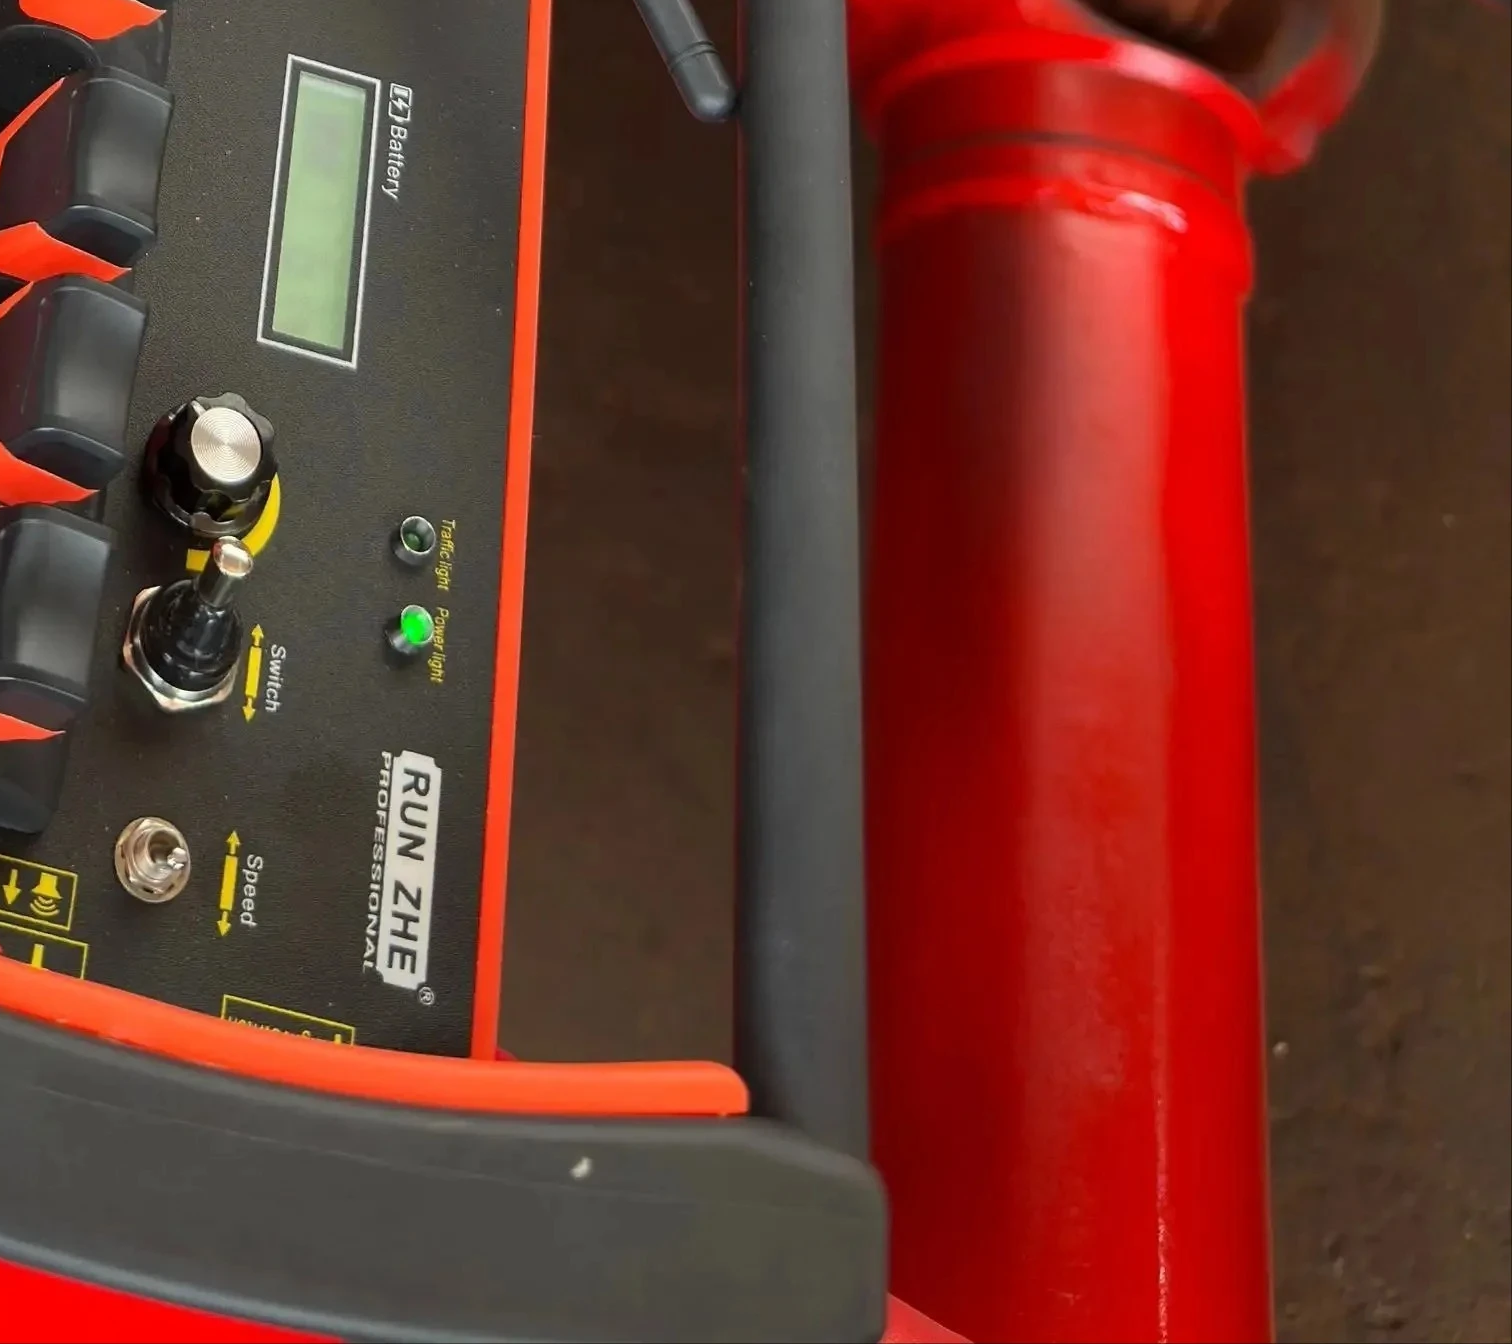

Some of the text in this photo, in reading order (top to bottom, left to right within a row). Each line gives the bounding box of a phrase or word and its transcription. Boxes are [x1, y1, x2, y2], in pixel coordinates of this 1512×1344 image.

[381, 124, 408, 200] Battery
[434, 519, 456, 592] Traffic light
[265, 643, 287, 713] Switch
[427, 607, 450, 683] Power light
[240, 853, 263, 928] Speed
[362, 750, 392, 974] PROFESSIONAL
[387, 767, 431, 975] RUN ZHE
